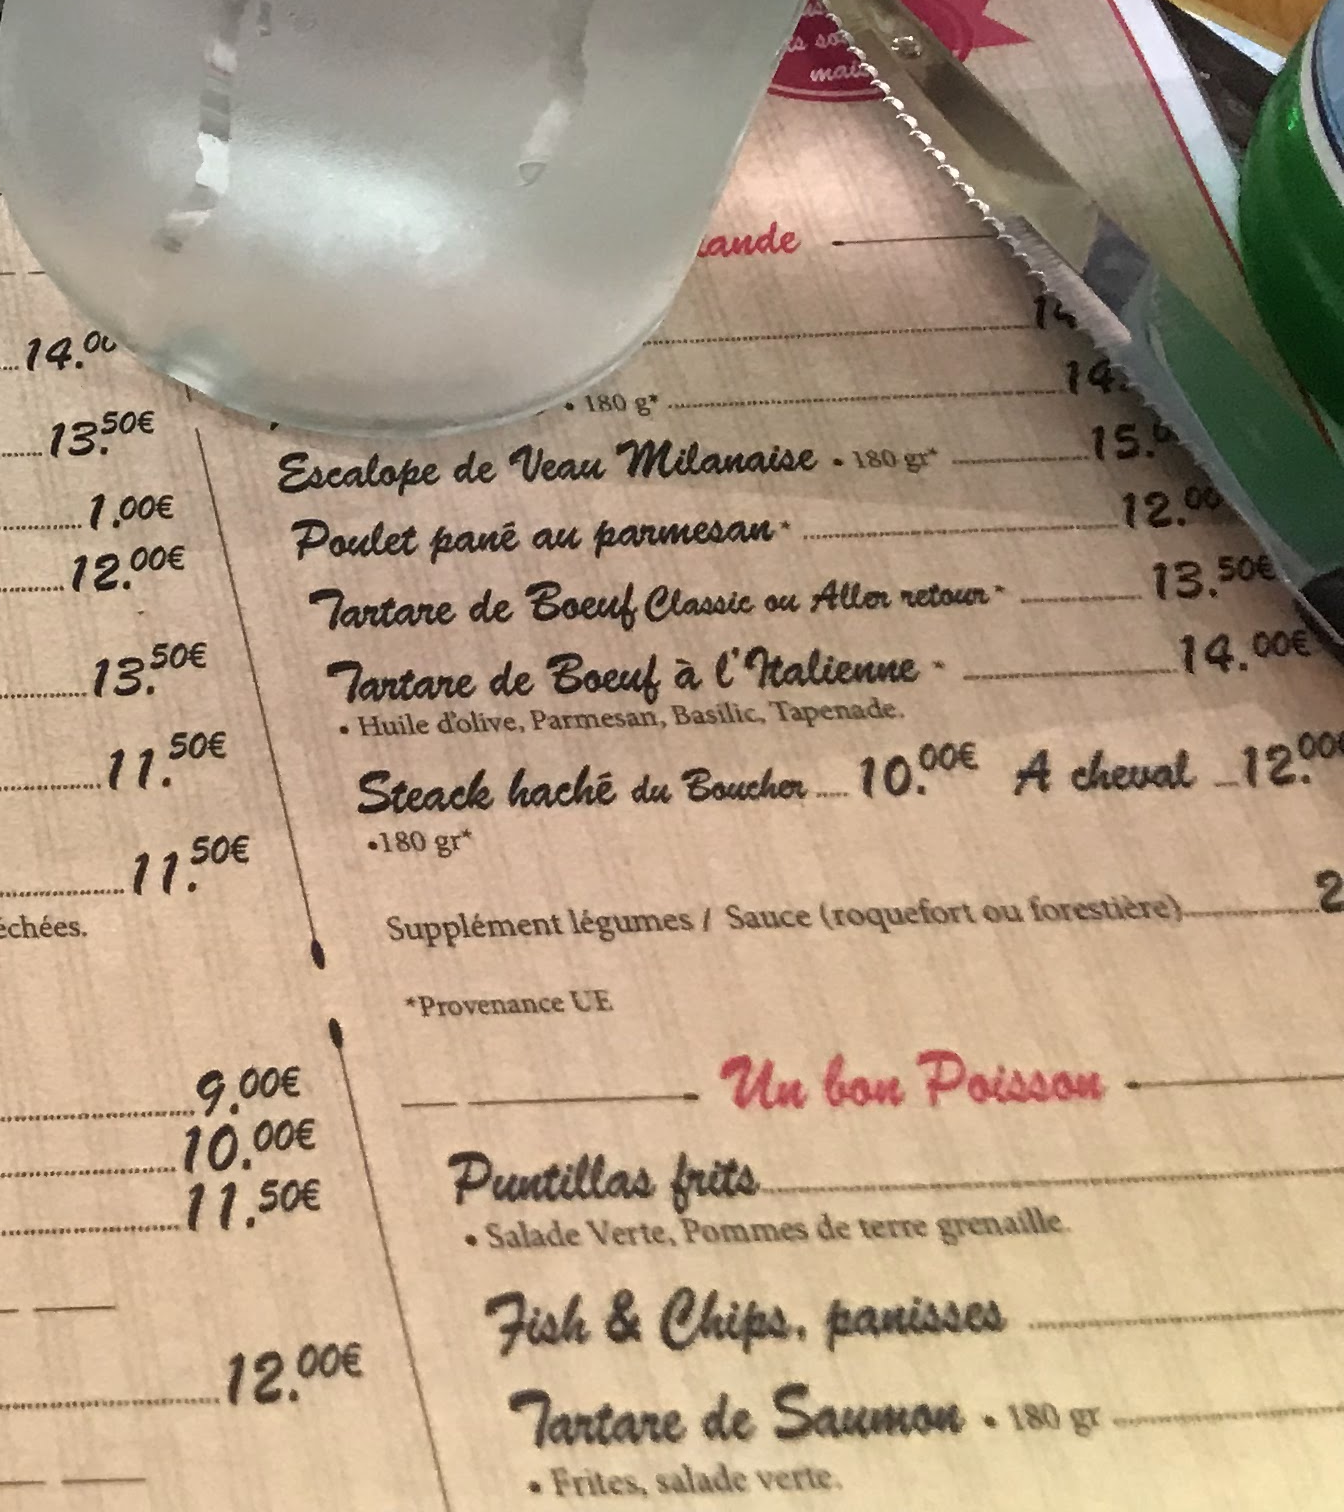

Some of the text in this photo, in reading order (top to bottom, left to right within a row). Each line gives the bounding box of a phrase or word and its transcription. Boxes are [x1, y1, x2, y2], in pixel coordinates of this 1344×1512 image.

[278, 439, 818, 496] Escalope de Veau Milanaise
[291, 519, 419, 560] Poulet
[532, 527, 582, 551] au
[327, 660, 477, 704] Tartare
[489, 660, 534, 697] de
[546, 653, 661, 705] Boeuf
[674, 658, 703, 691] à
[357, 769, 494, 814] Steack
[631, 774, 672, 804] du
[681, 767, 809, 802] Boucher
[1014, 749, 1052, 796] A
[1071, 749, 1197, 792] cheval
[386, 894, 1188, 948] Supplément légumes Sauce (roquefort ou forestière)
[720, 1049, 1105, 1110] Un bon Poisson
[448, 1151, 760, 1216] Puntillas frits
[485, 1287, 1007, 1357] Fish & Chips, panisses
[508, 1382, 966, 1449] Tartare de Saumon
